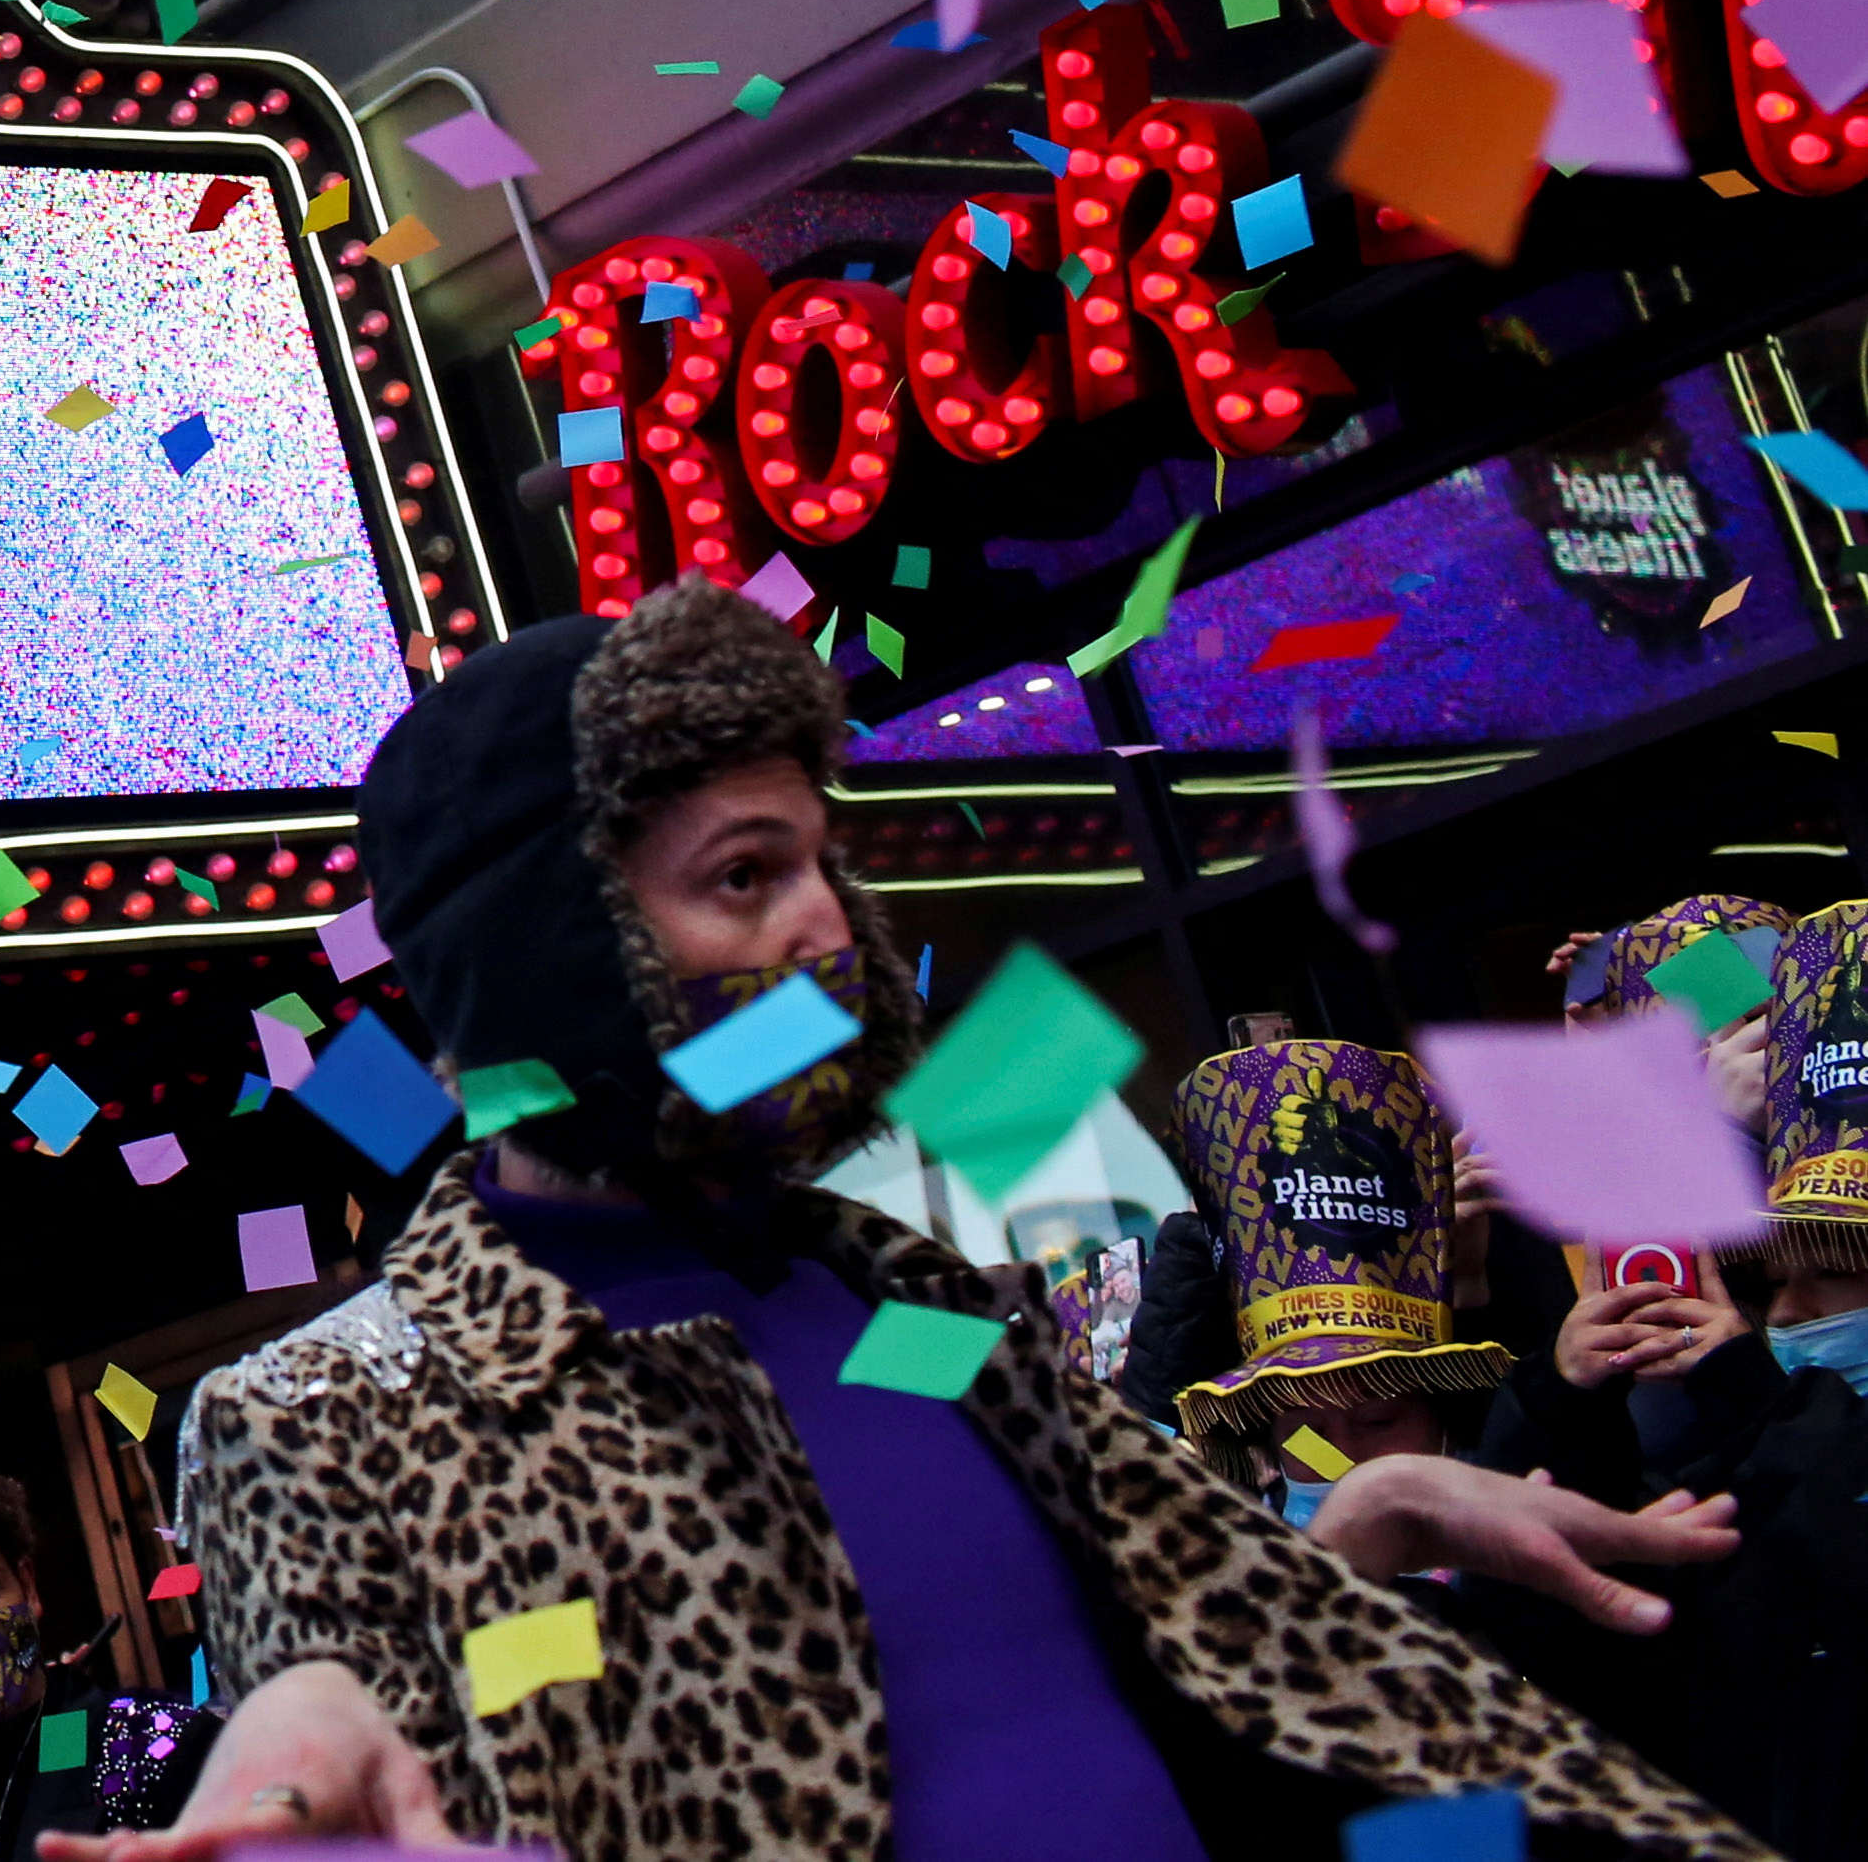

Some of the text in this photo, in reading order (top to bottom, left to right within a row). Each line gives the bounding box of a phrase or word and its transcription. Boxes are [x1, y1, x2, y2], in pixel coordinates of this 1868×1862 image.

[521, 6, 1315, 620] Rock
[1272, 1168, 1386, 1205] planet
[1291, 1193, 1408, 1229] fitness
[1278, 1291, 1435, 1324] TIMES SQUARE
[1264, 1313, 1311, 1342] NEW
[1318, 1310, 1395, 1332] YEARS
[1399, 1316, 1436, 1342] EVE
